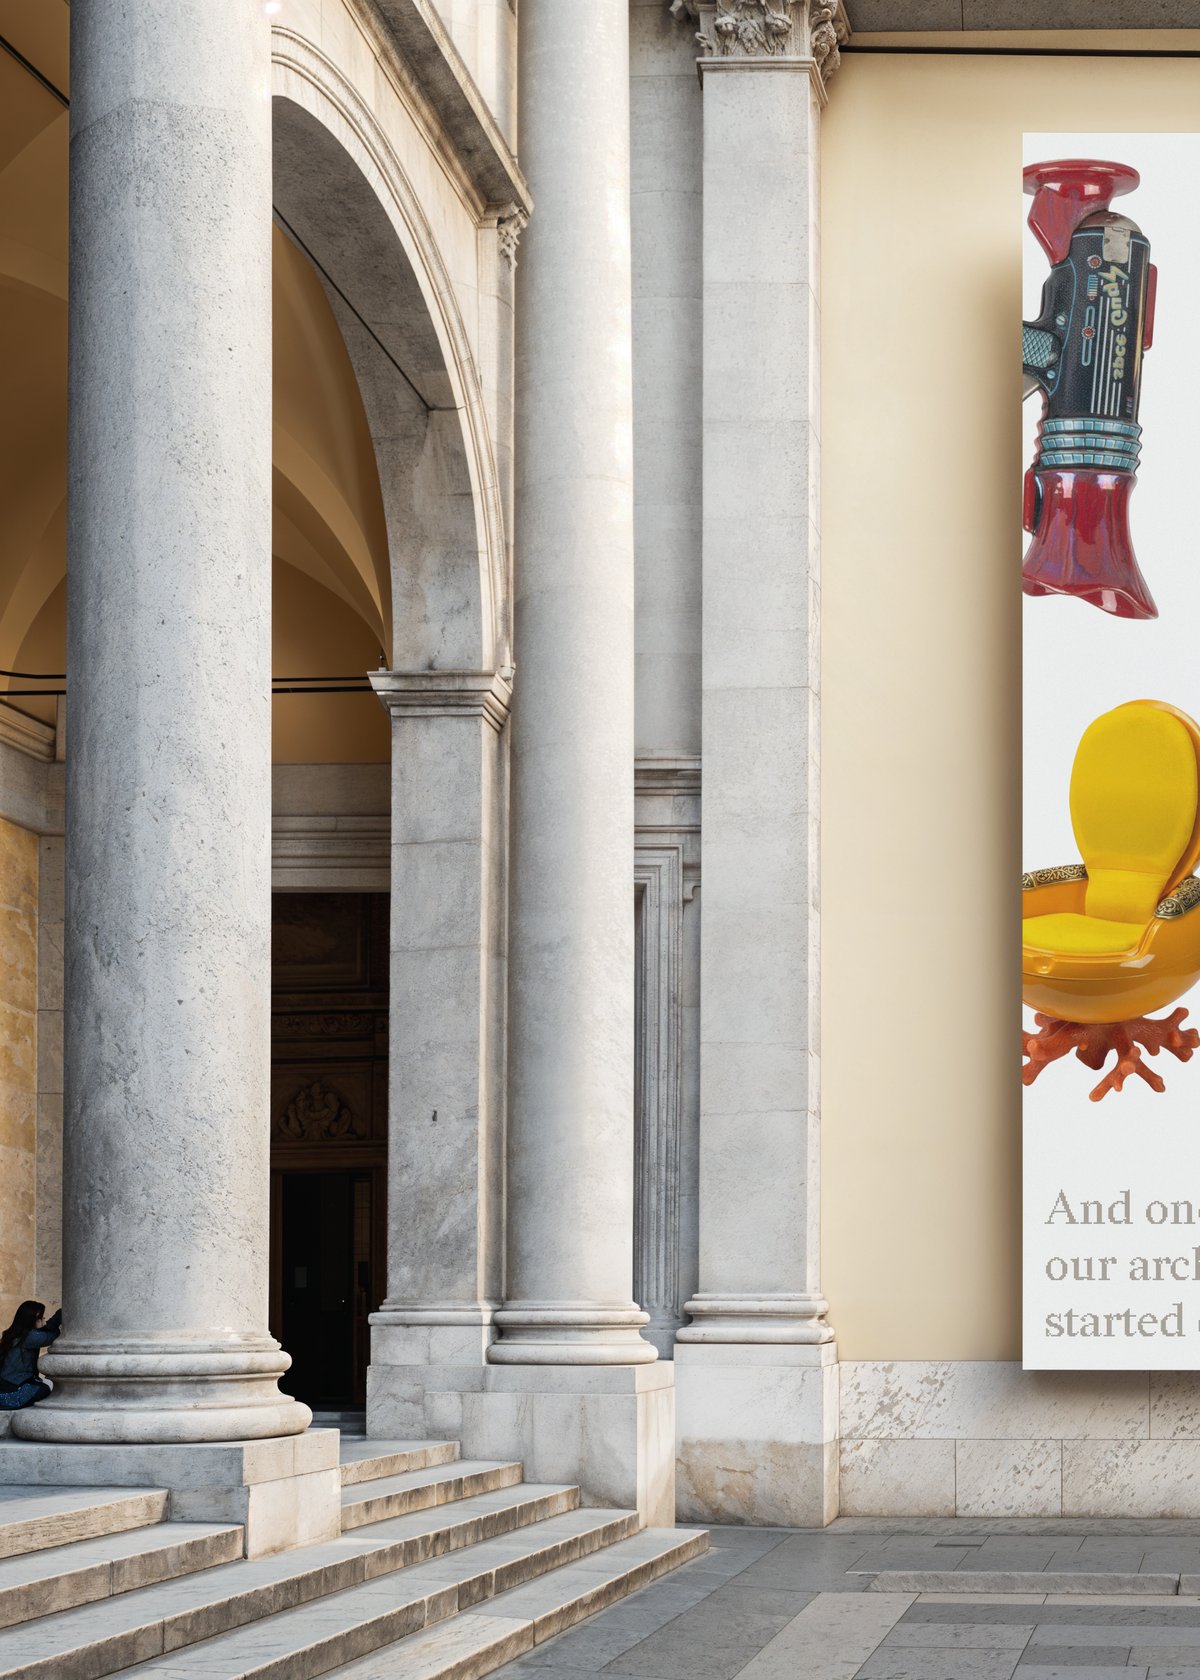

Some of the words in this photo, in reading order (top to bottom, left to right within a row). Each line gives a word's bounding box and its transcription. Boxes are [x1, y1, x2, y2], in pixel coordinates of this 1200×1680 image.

[1044, 1188, 1134, 1225] And
[1045, 1256, 1118, 1281] our
[1045, 1301, 1187, 1338] started
